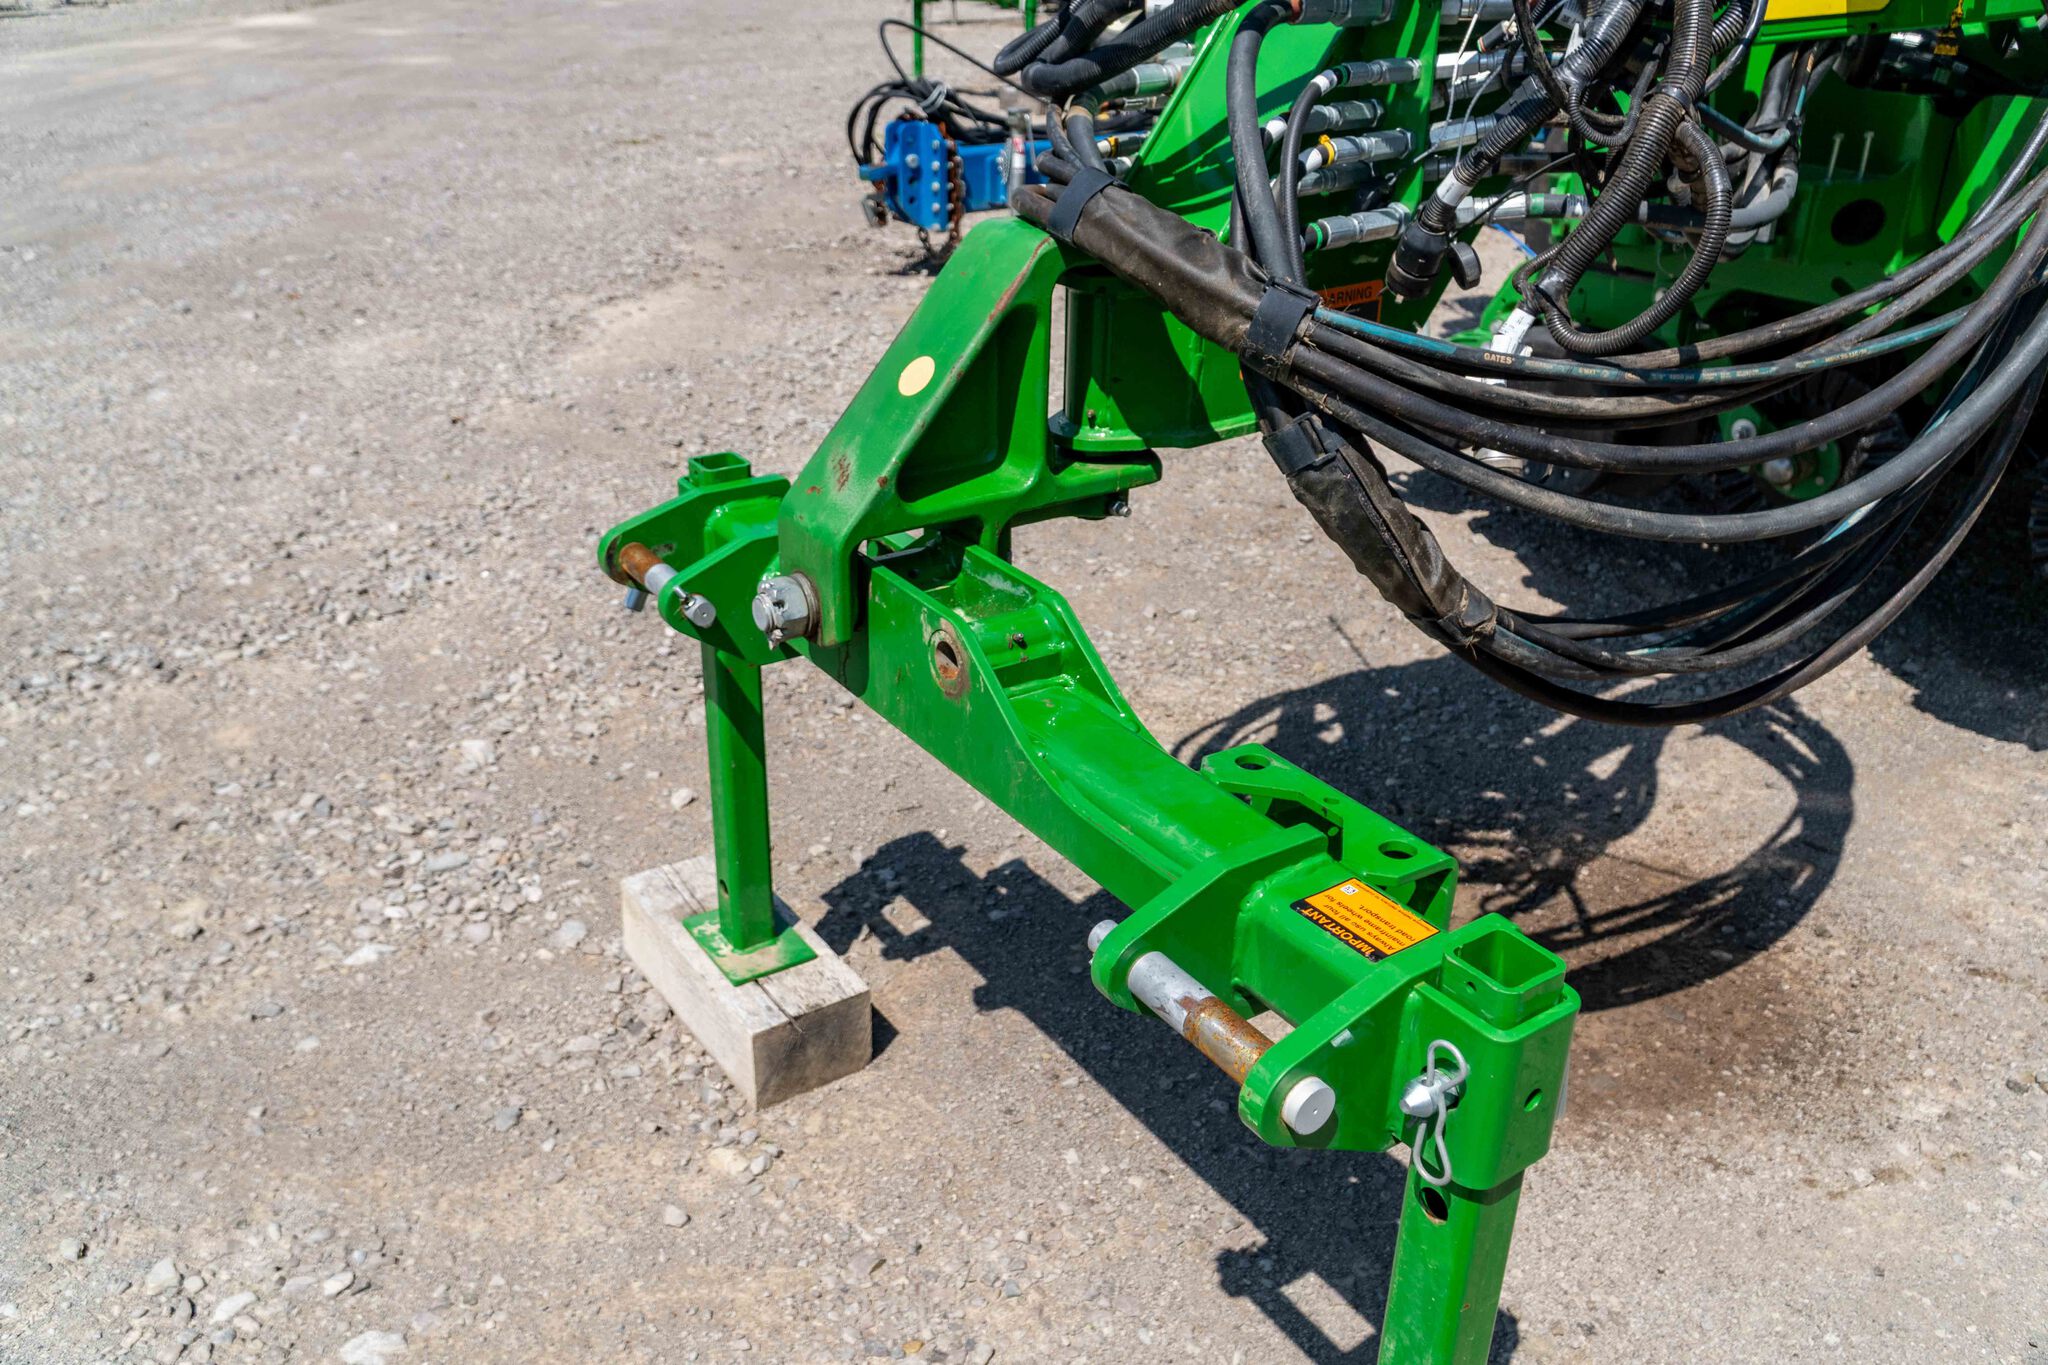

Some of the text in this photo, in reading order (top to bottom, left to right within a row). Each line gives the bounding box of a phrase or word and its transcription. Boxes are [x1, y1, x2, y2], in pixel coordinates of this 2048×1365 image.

[1322, 286, 1373, 305] ARNING
[1483, 352, 1513, 365] GATES
[1334, 901, 1364, 919] wheels
[1300, 906, 1376, 955] IMPORTANT
[1361, 918, 1406, 946] mainframe
[1394, 928, 1416, 942] road
[1364, 930, 1397, 951] Always
